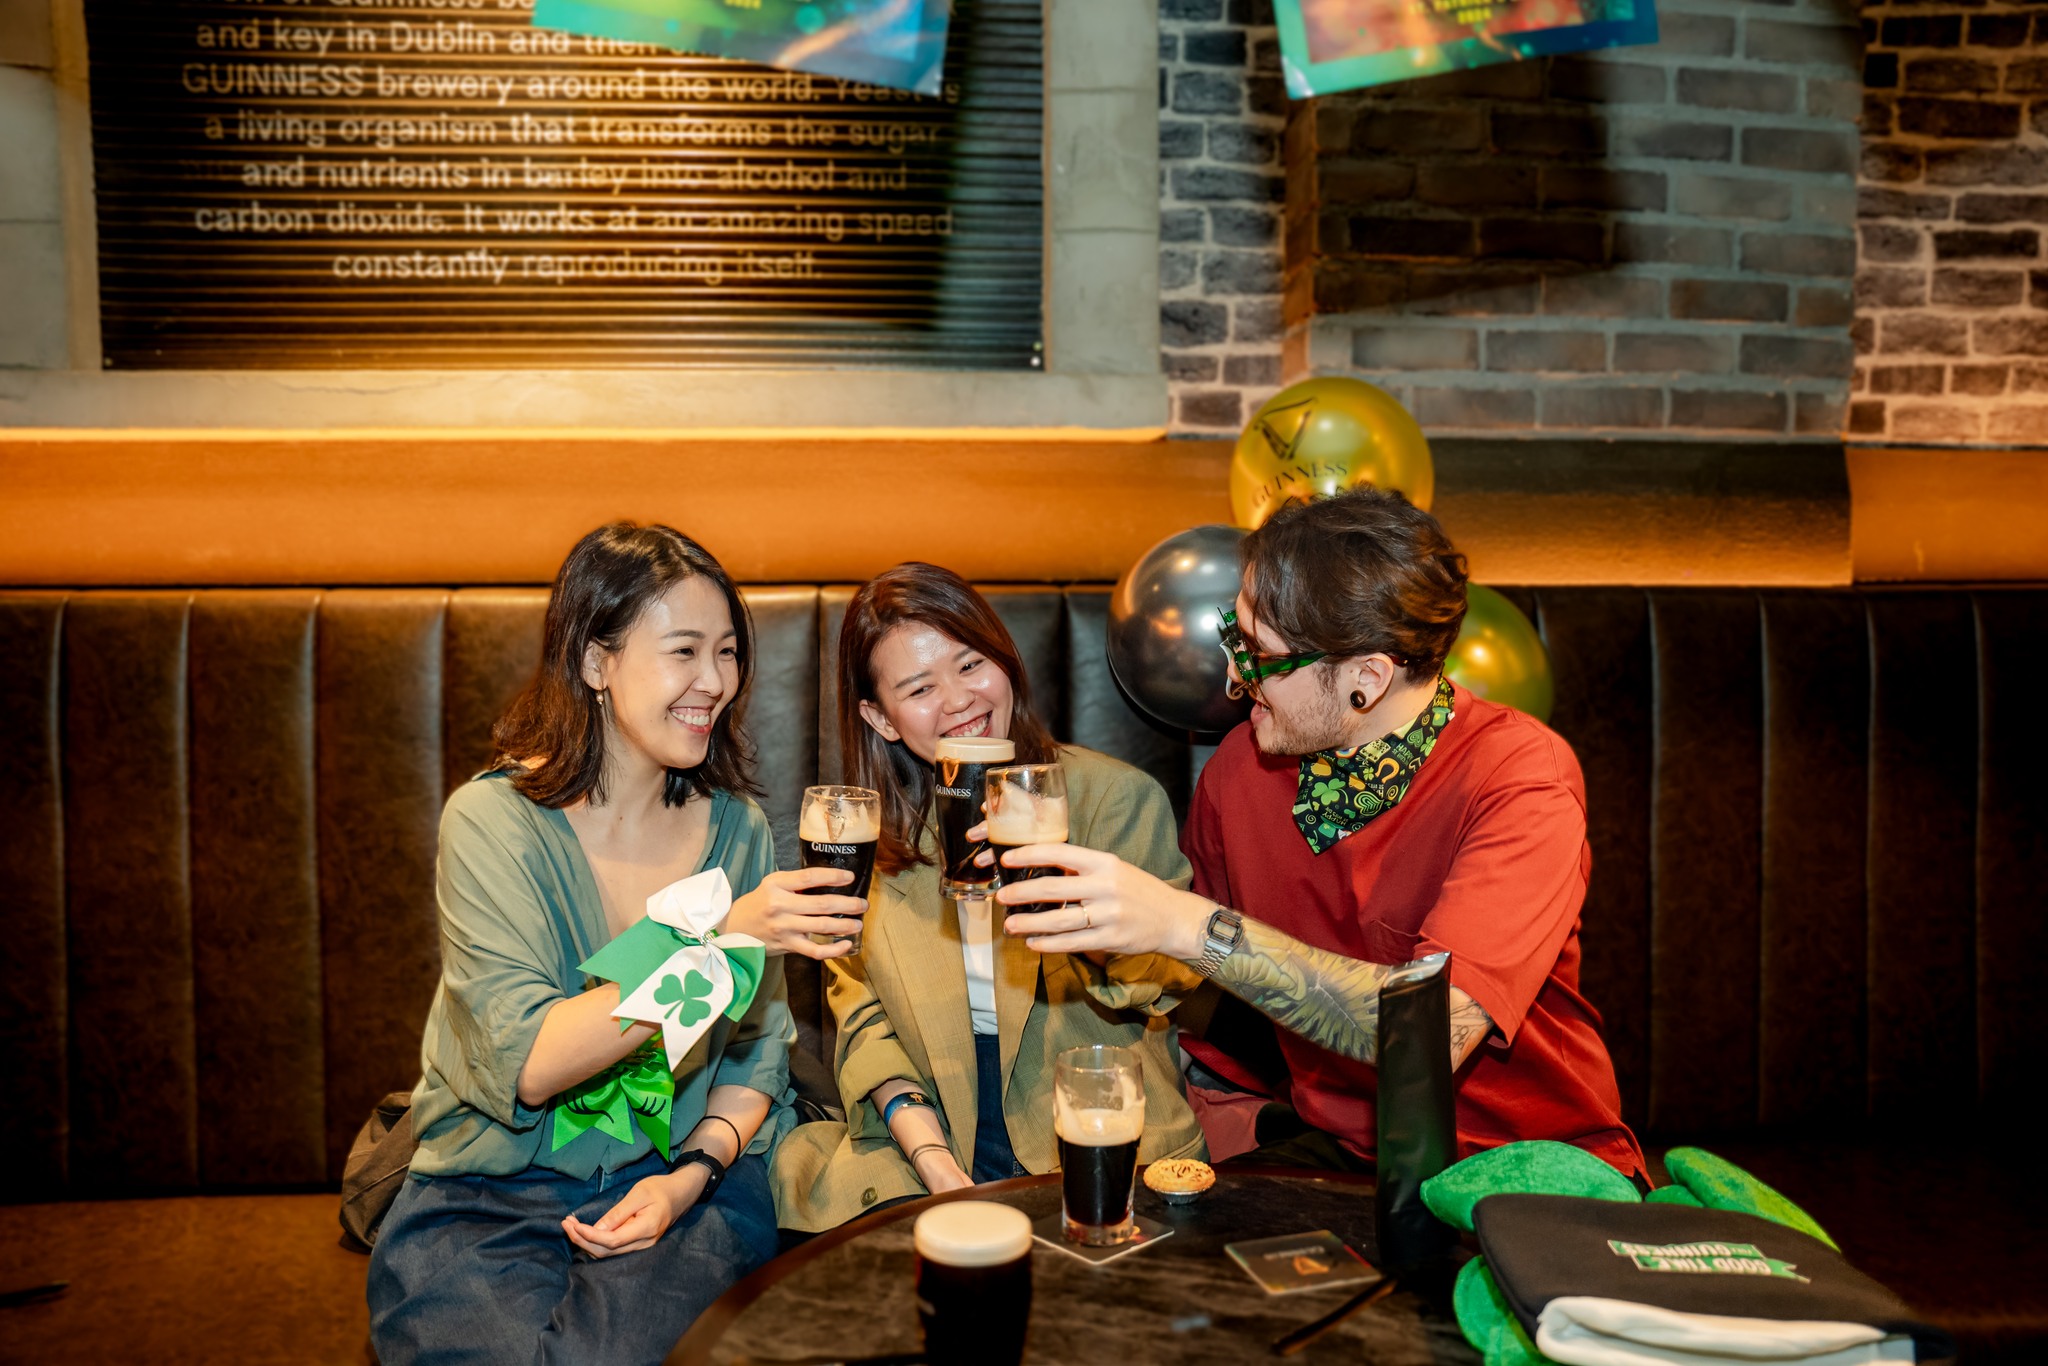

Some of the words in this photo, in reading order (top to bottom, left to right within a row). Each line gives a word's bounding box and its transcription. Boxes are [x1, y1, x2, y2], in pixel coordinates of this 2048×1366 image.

[197, 18, 260, 48] and
[273, 18, 334, 57] key
[346, 20, 376, 51] in
[391, 21, 496, 53] Dublin
[508, 29, 570, 54] and
[182, 63, 364, 95] GUINNESS
[377, 64, 513, 107] brewery
[527, 69, 644, 98] around
[659, 70, 711, 100] the
[722, 71, 821, 101] world.
[204, 115, 224, 140] a
[238, 108, 326, 148] living
[339, 113, 496, 149] organism
[511, 114, 574, 143] that
[589, 115, 773, 144] transforms
[785, 115, 836, 145] the
[850, 122, 938, 153] sugar
[243, 155, 305, 187] and
[318, 157, 469, 188] nutrients
[481, 158, 510, 188] in
[525, 157, 627, 196] barley
[641, 158, 703, 190] into
[718, 158, 836, 191] alcohol
[848, 163, 906, 191] and
[195, 202, 314, 233] carbon
[464, 203, 485, 232] It
[498, 203, 594, 232] works
[607, 207, 637, 233] at
[652, 212, 692, 234] an
[706, 204, 844, 241] amazing
[858, 206, 952, 242] speed
[333, 247, 508, 285] constantly
[523, 249, 722, 286] reproducing
[1253, 462, 1348, 509] GUINNESS
[935, 784, 972, 797] GUINNESS
[811, 841, 857, 854] GUINNESS
[1620, 1243, 1731, 1256] GUINNESS
[1651, 1256, 1711, 1272] TIME
[1713, 1257, 1773, 1276] GOOD
